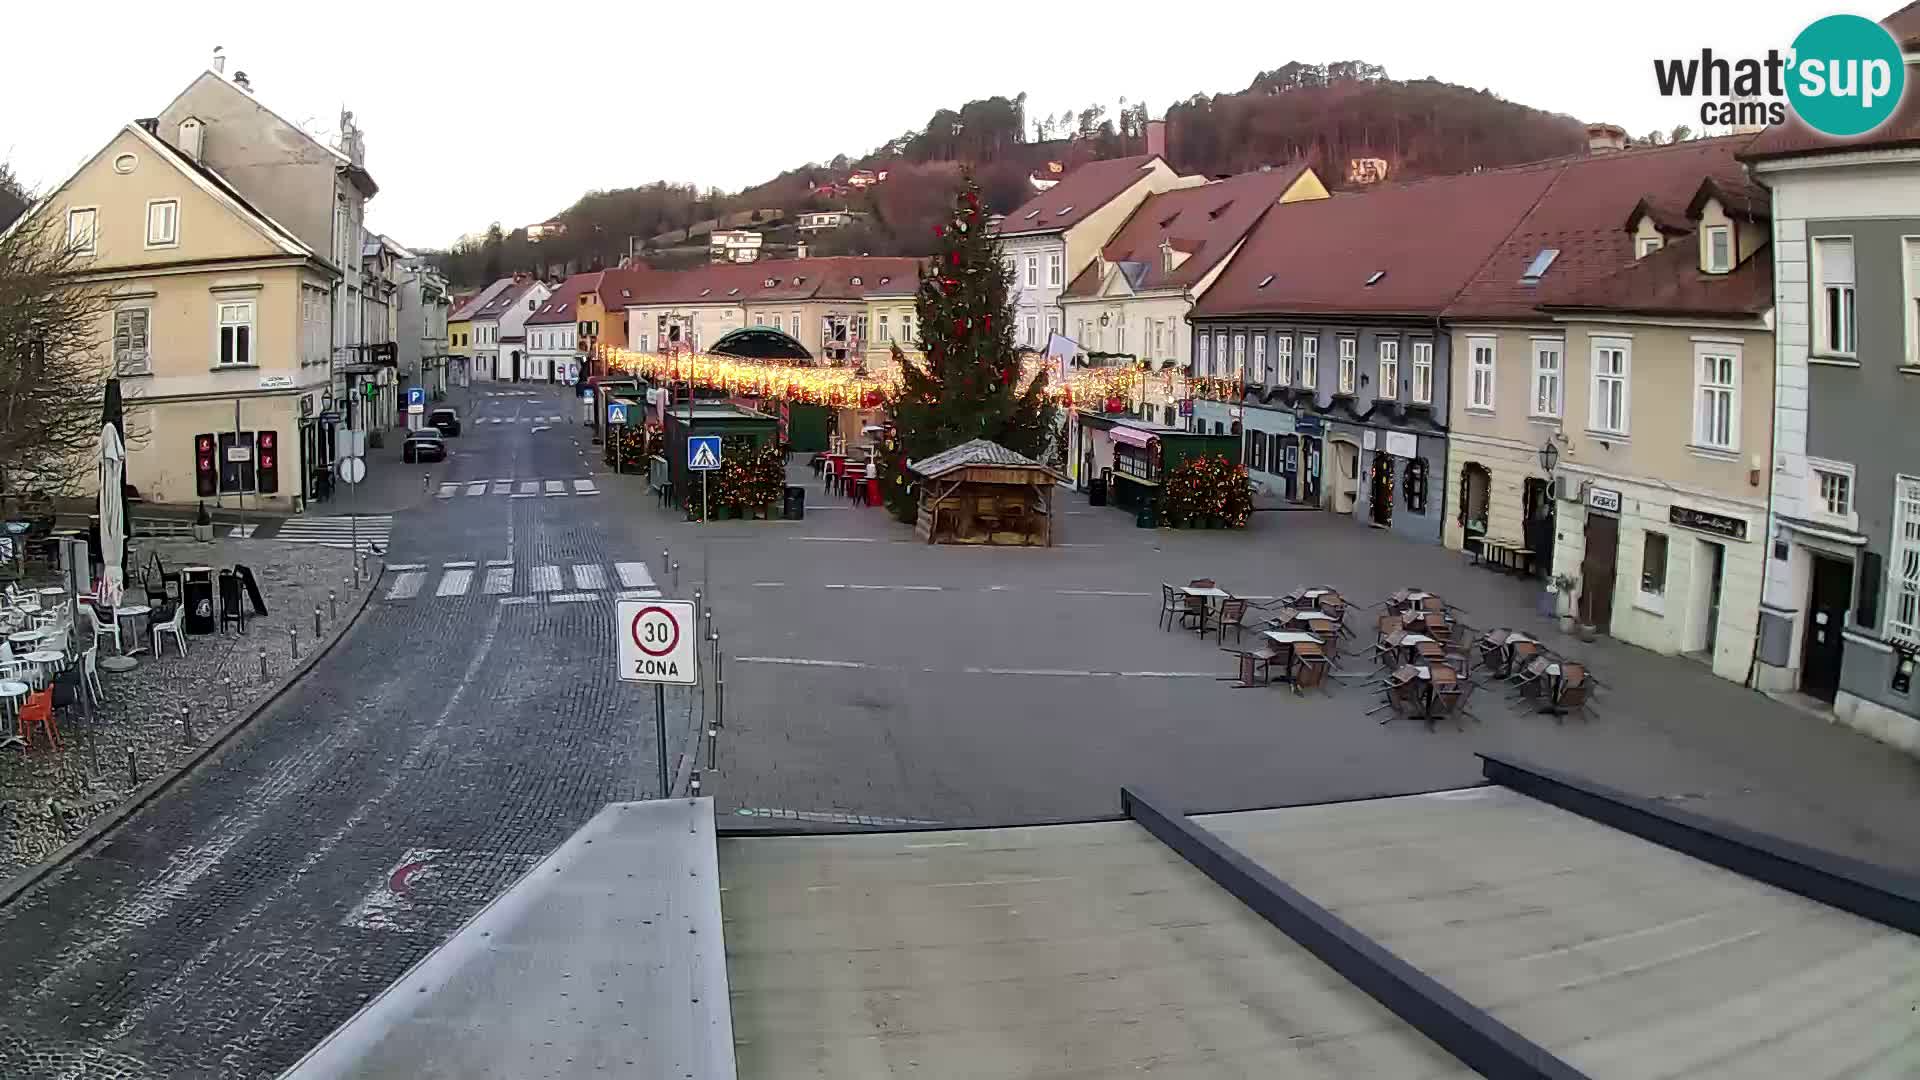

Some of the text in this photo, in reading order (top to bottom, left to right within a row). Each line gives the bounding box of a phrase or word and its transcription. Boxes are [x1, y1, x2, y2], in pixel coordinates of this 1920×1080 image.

[412, 391, 420, 402] P
[645, 622, 668, 644] 30
[635, 660, 679, 676] ZONA
